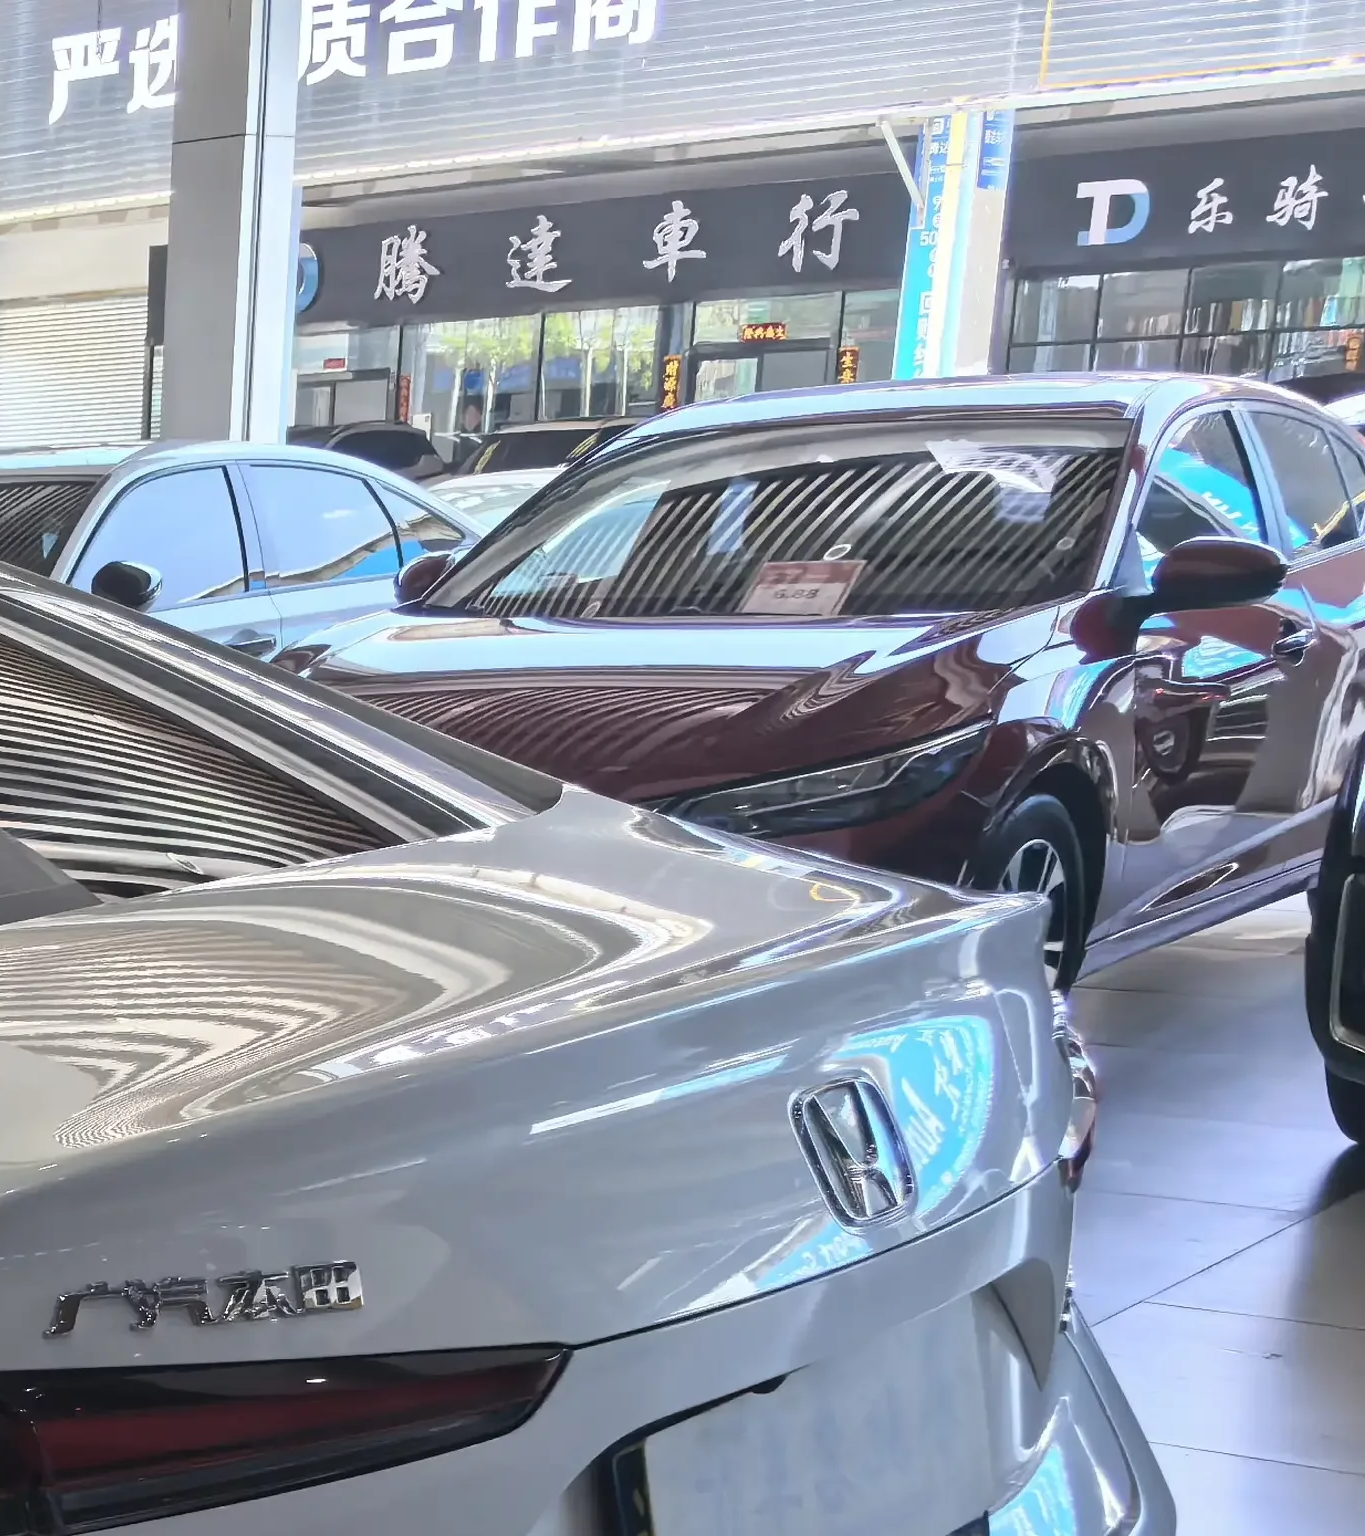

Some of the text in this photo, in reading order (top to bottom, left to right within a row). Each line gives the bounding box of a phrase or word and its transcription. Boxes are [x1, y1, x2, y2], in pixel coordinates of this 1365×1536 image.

[1188, 164, 1365, 234] 乐骑
[42, 1260, 365, 1340] 广汽本田
